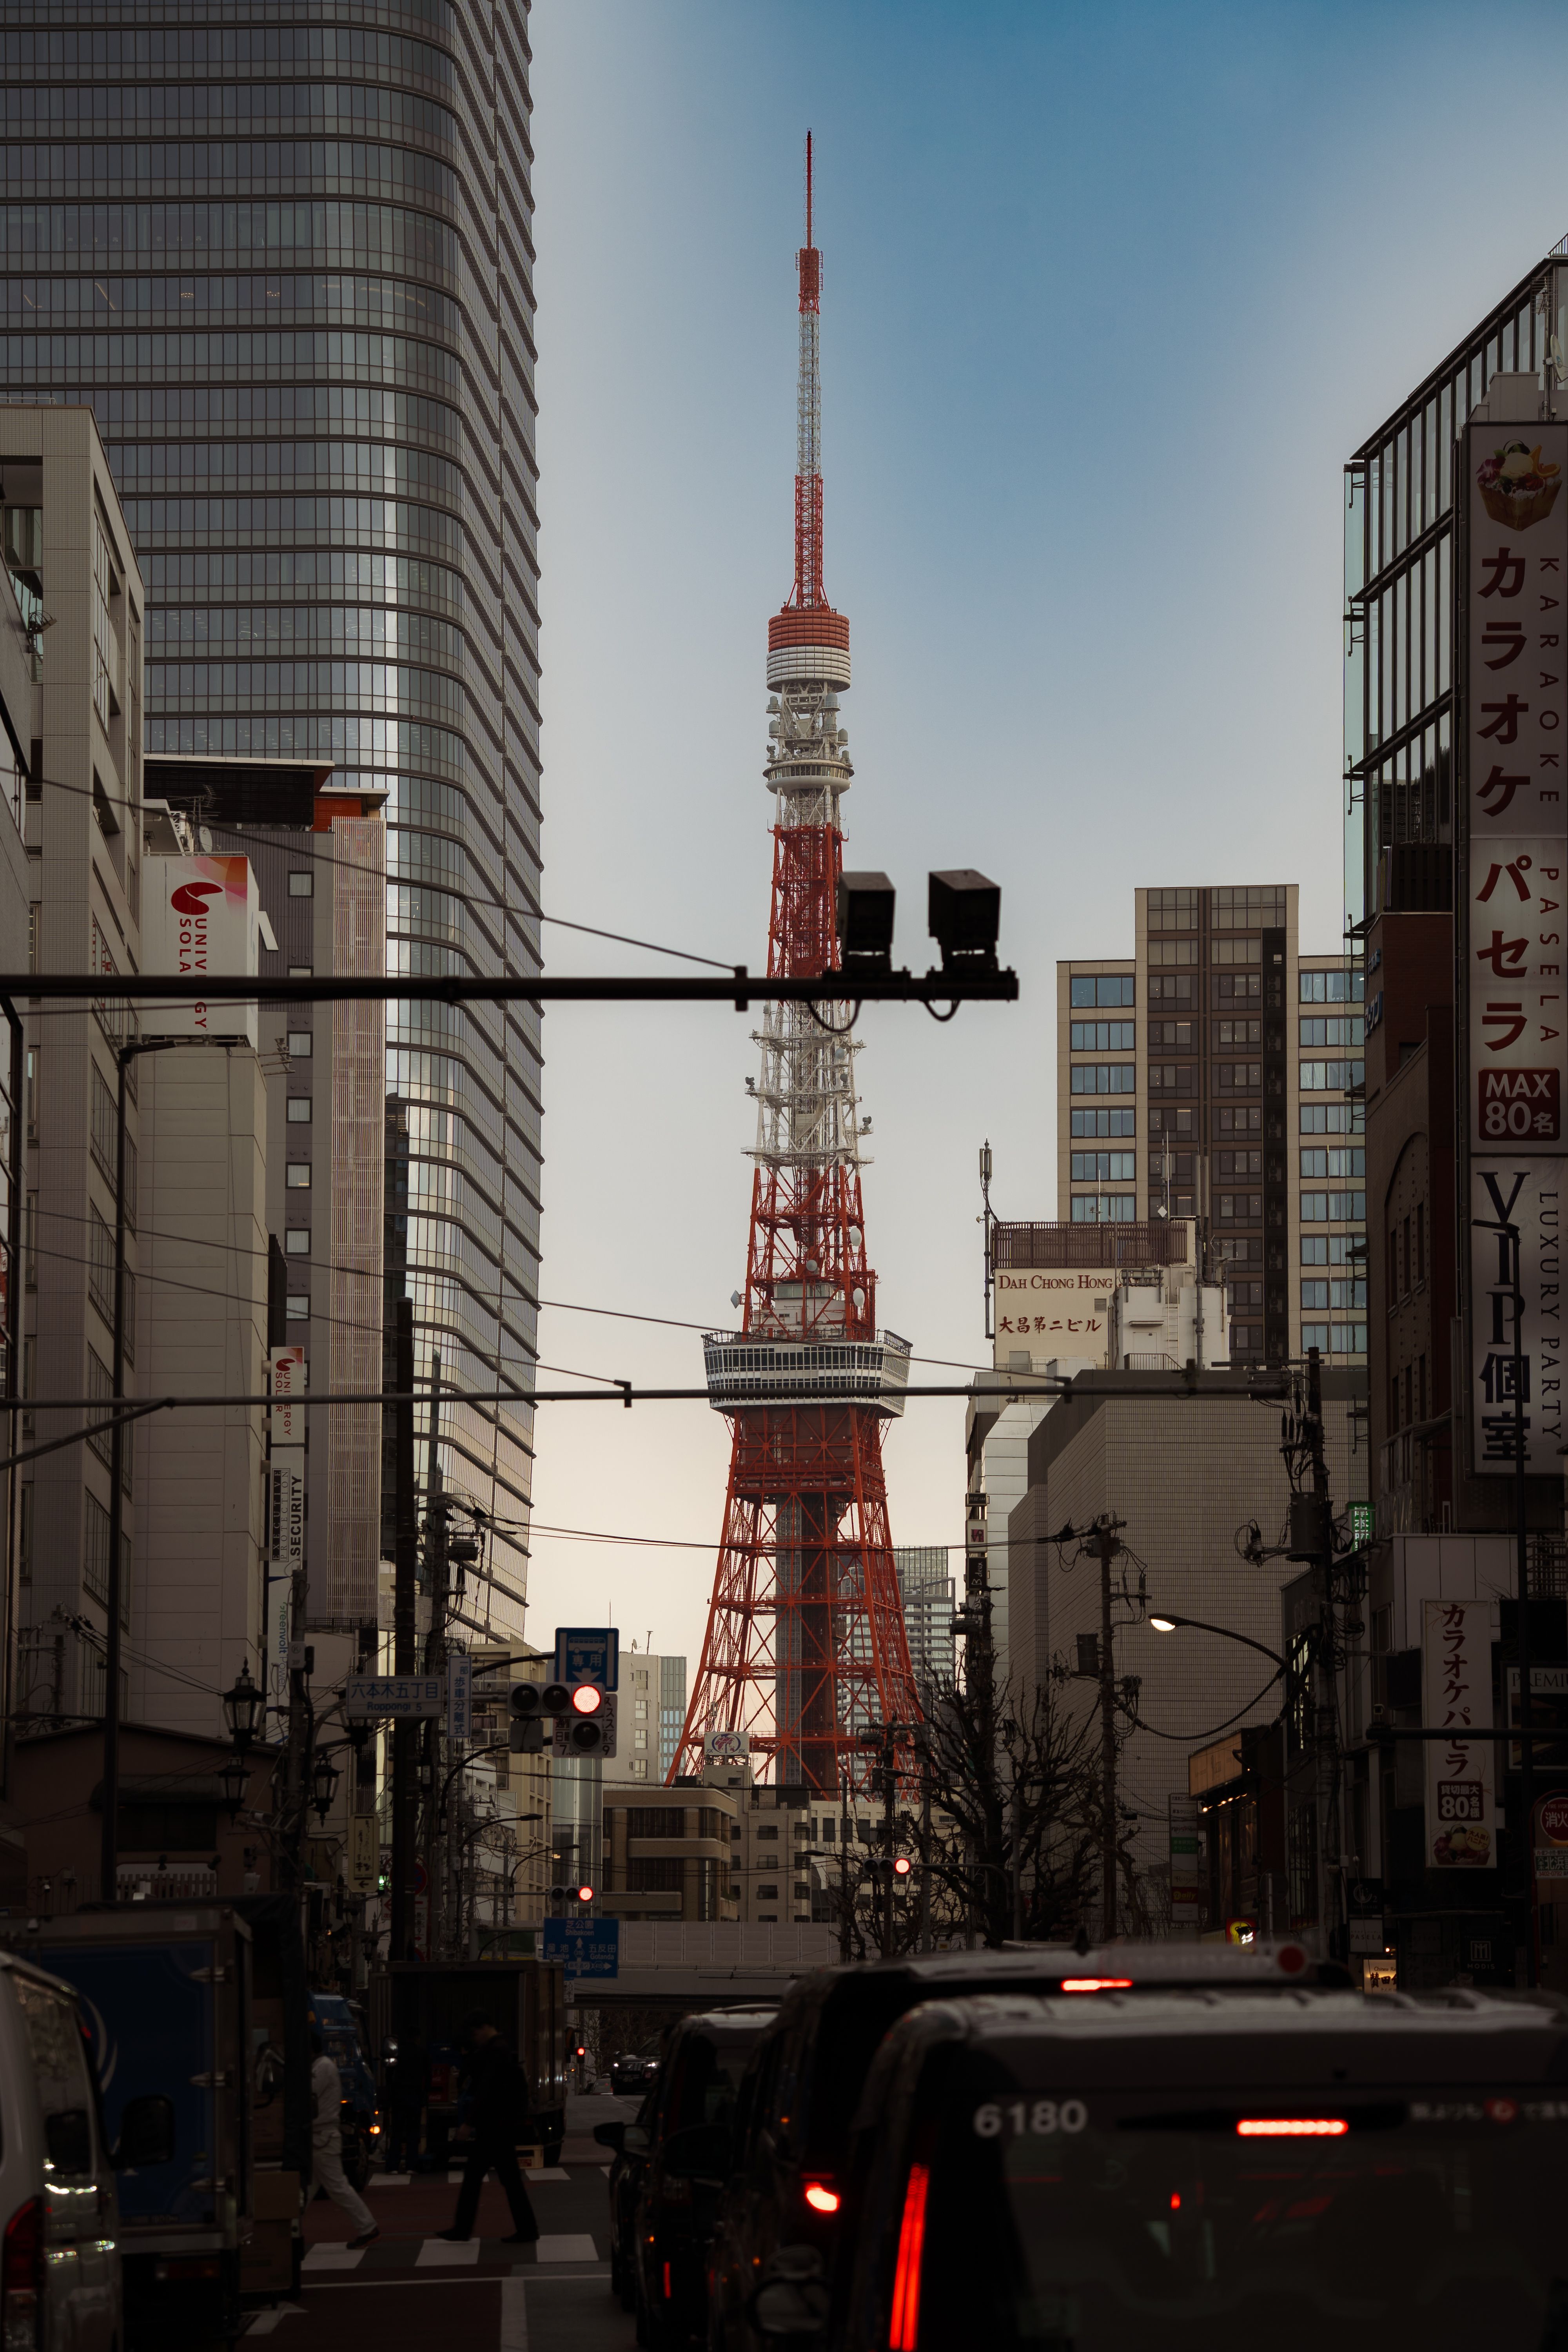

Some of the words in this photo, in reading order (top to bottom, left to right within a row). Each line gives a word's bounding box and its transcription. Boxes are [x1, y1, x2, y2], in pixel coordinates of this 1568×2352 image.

[1477, 547, 1530, 817] カラオケ
[1539, 557, 1559, 802] KARAOKE
[180, 918, 191, 973] SOLA
[1475, 855, 1532, 1051] パセラ
[1539, 868, 1559, 1042] PASELA
[195, 918, 207, 1028] UNIVGY
[1486, 1073, 1551, 1098] MAX
[1539, 1191, 1560, 1320] LUXURY
[998, 1316, 1102, 1334] 大昌第二ビル
[1541, 1337, 1562, 1439] PARTY
[273, 1471, 281, 1560] EXECUTIVE
[290, 1476, 302, 1556] SECURITY
[572, 1654, 602, 1667] 専用
[1512, 1673, 1568, 1686] PEMI
[351, 1682, 437, 1699] 六本木五丁目
[367, 1702, 410, 1712] Roppongi
[416, 1703, 422, 1711] 5
[454, 1677, 465, 1735] 歩車分離式
[1441, 1785, 1479, 1795] 貸切最大
[1545, 1811, 1568, 1828] 消火
[566, 1920, 594, 1929] 芝公園
[589, 1944, 616, 1953] 五反田
[973, 2098, 1089, 2138] 6180
